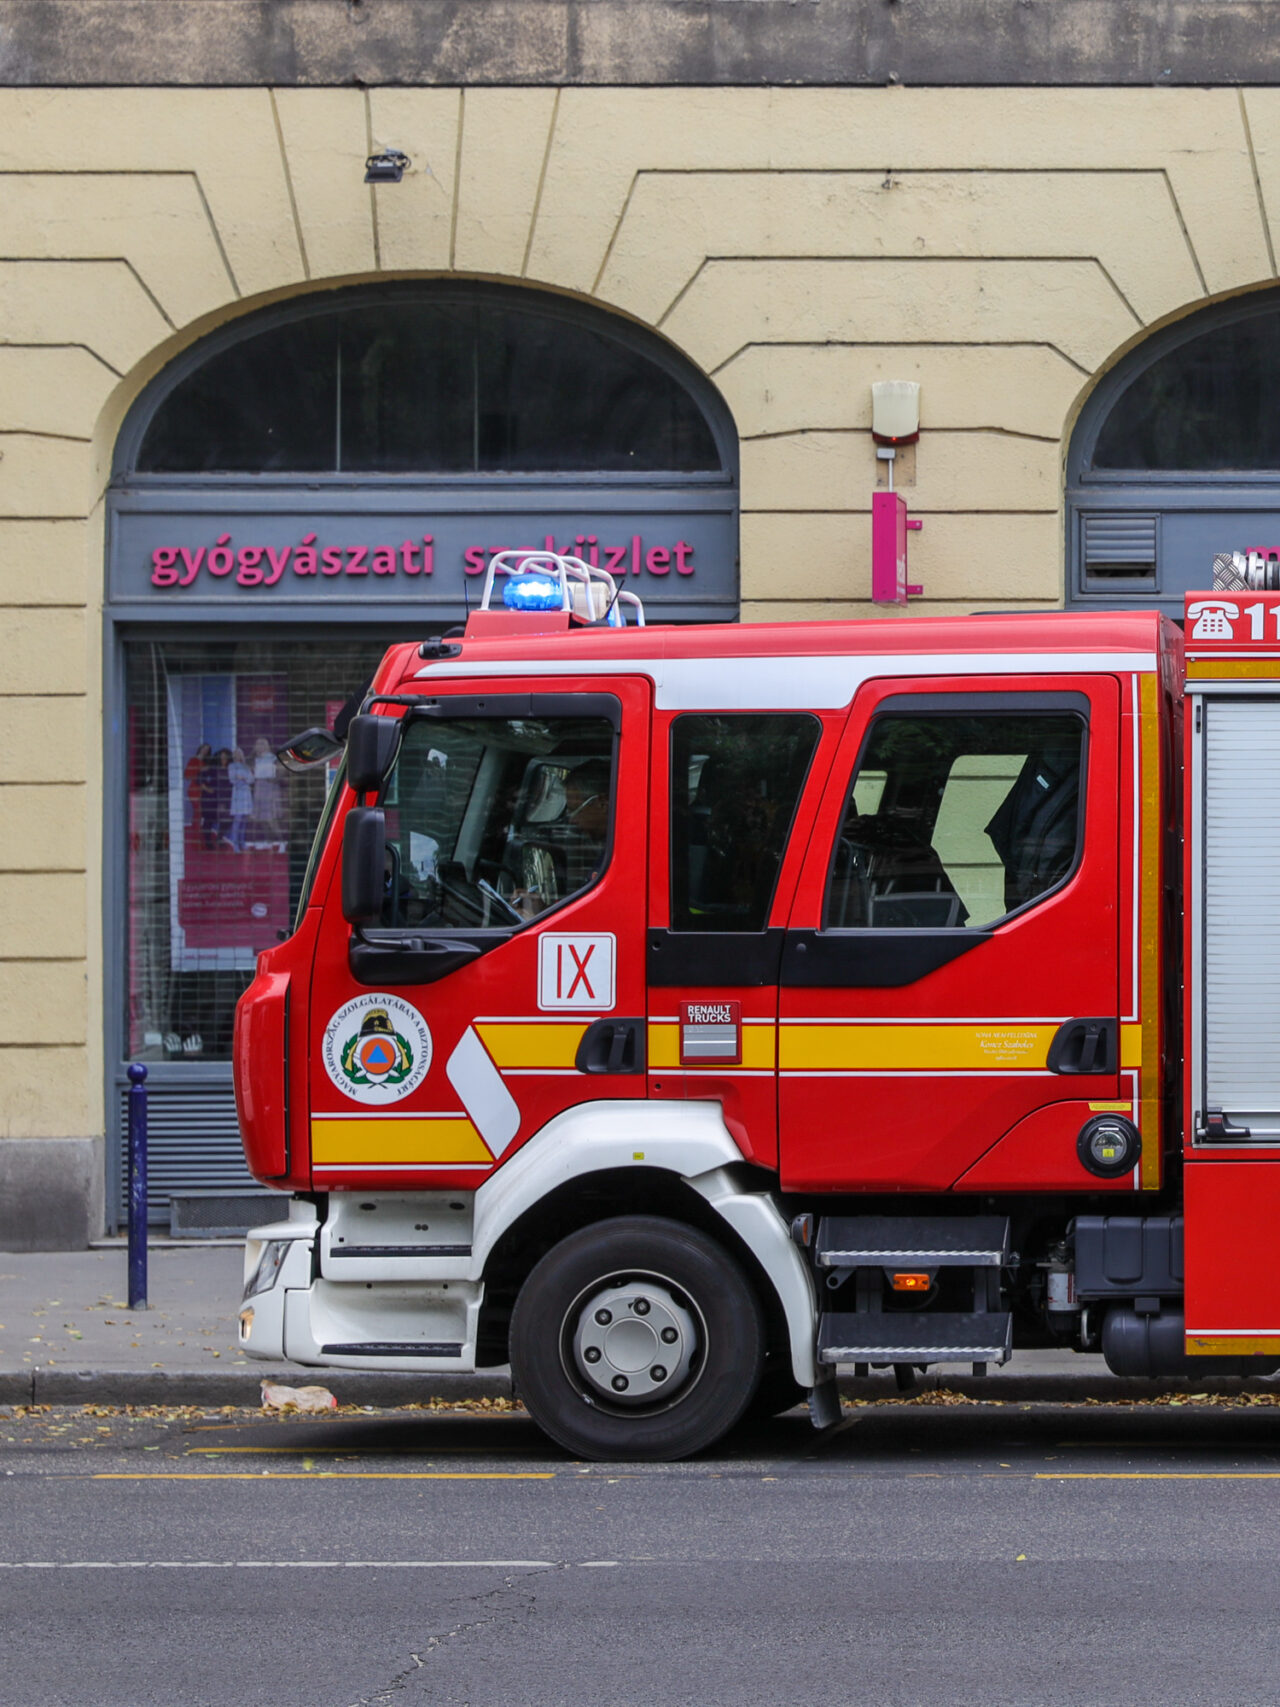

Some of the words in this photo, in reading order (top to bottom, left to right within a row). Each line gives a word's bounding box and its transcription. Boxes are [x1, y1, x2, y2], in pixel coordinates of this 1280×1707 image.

[151, 532, 434, 587] gyógyászati
[556, 944, 596, 999] IX
[338, 995, 416, 1021] SZOLGÁLATÁBAN
[687, 1005, 731, 1014] RENAULT
[688, 1014, 731, 1023] TRUCKS
[326, 1020, 358, 1096] MAGYARORSZÁG
[397, 1027, 428, 1095] BIZTONSÁGÉRT
